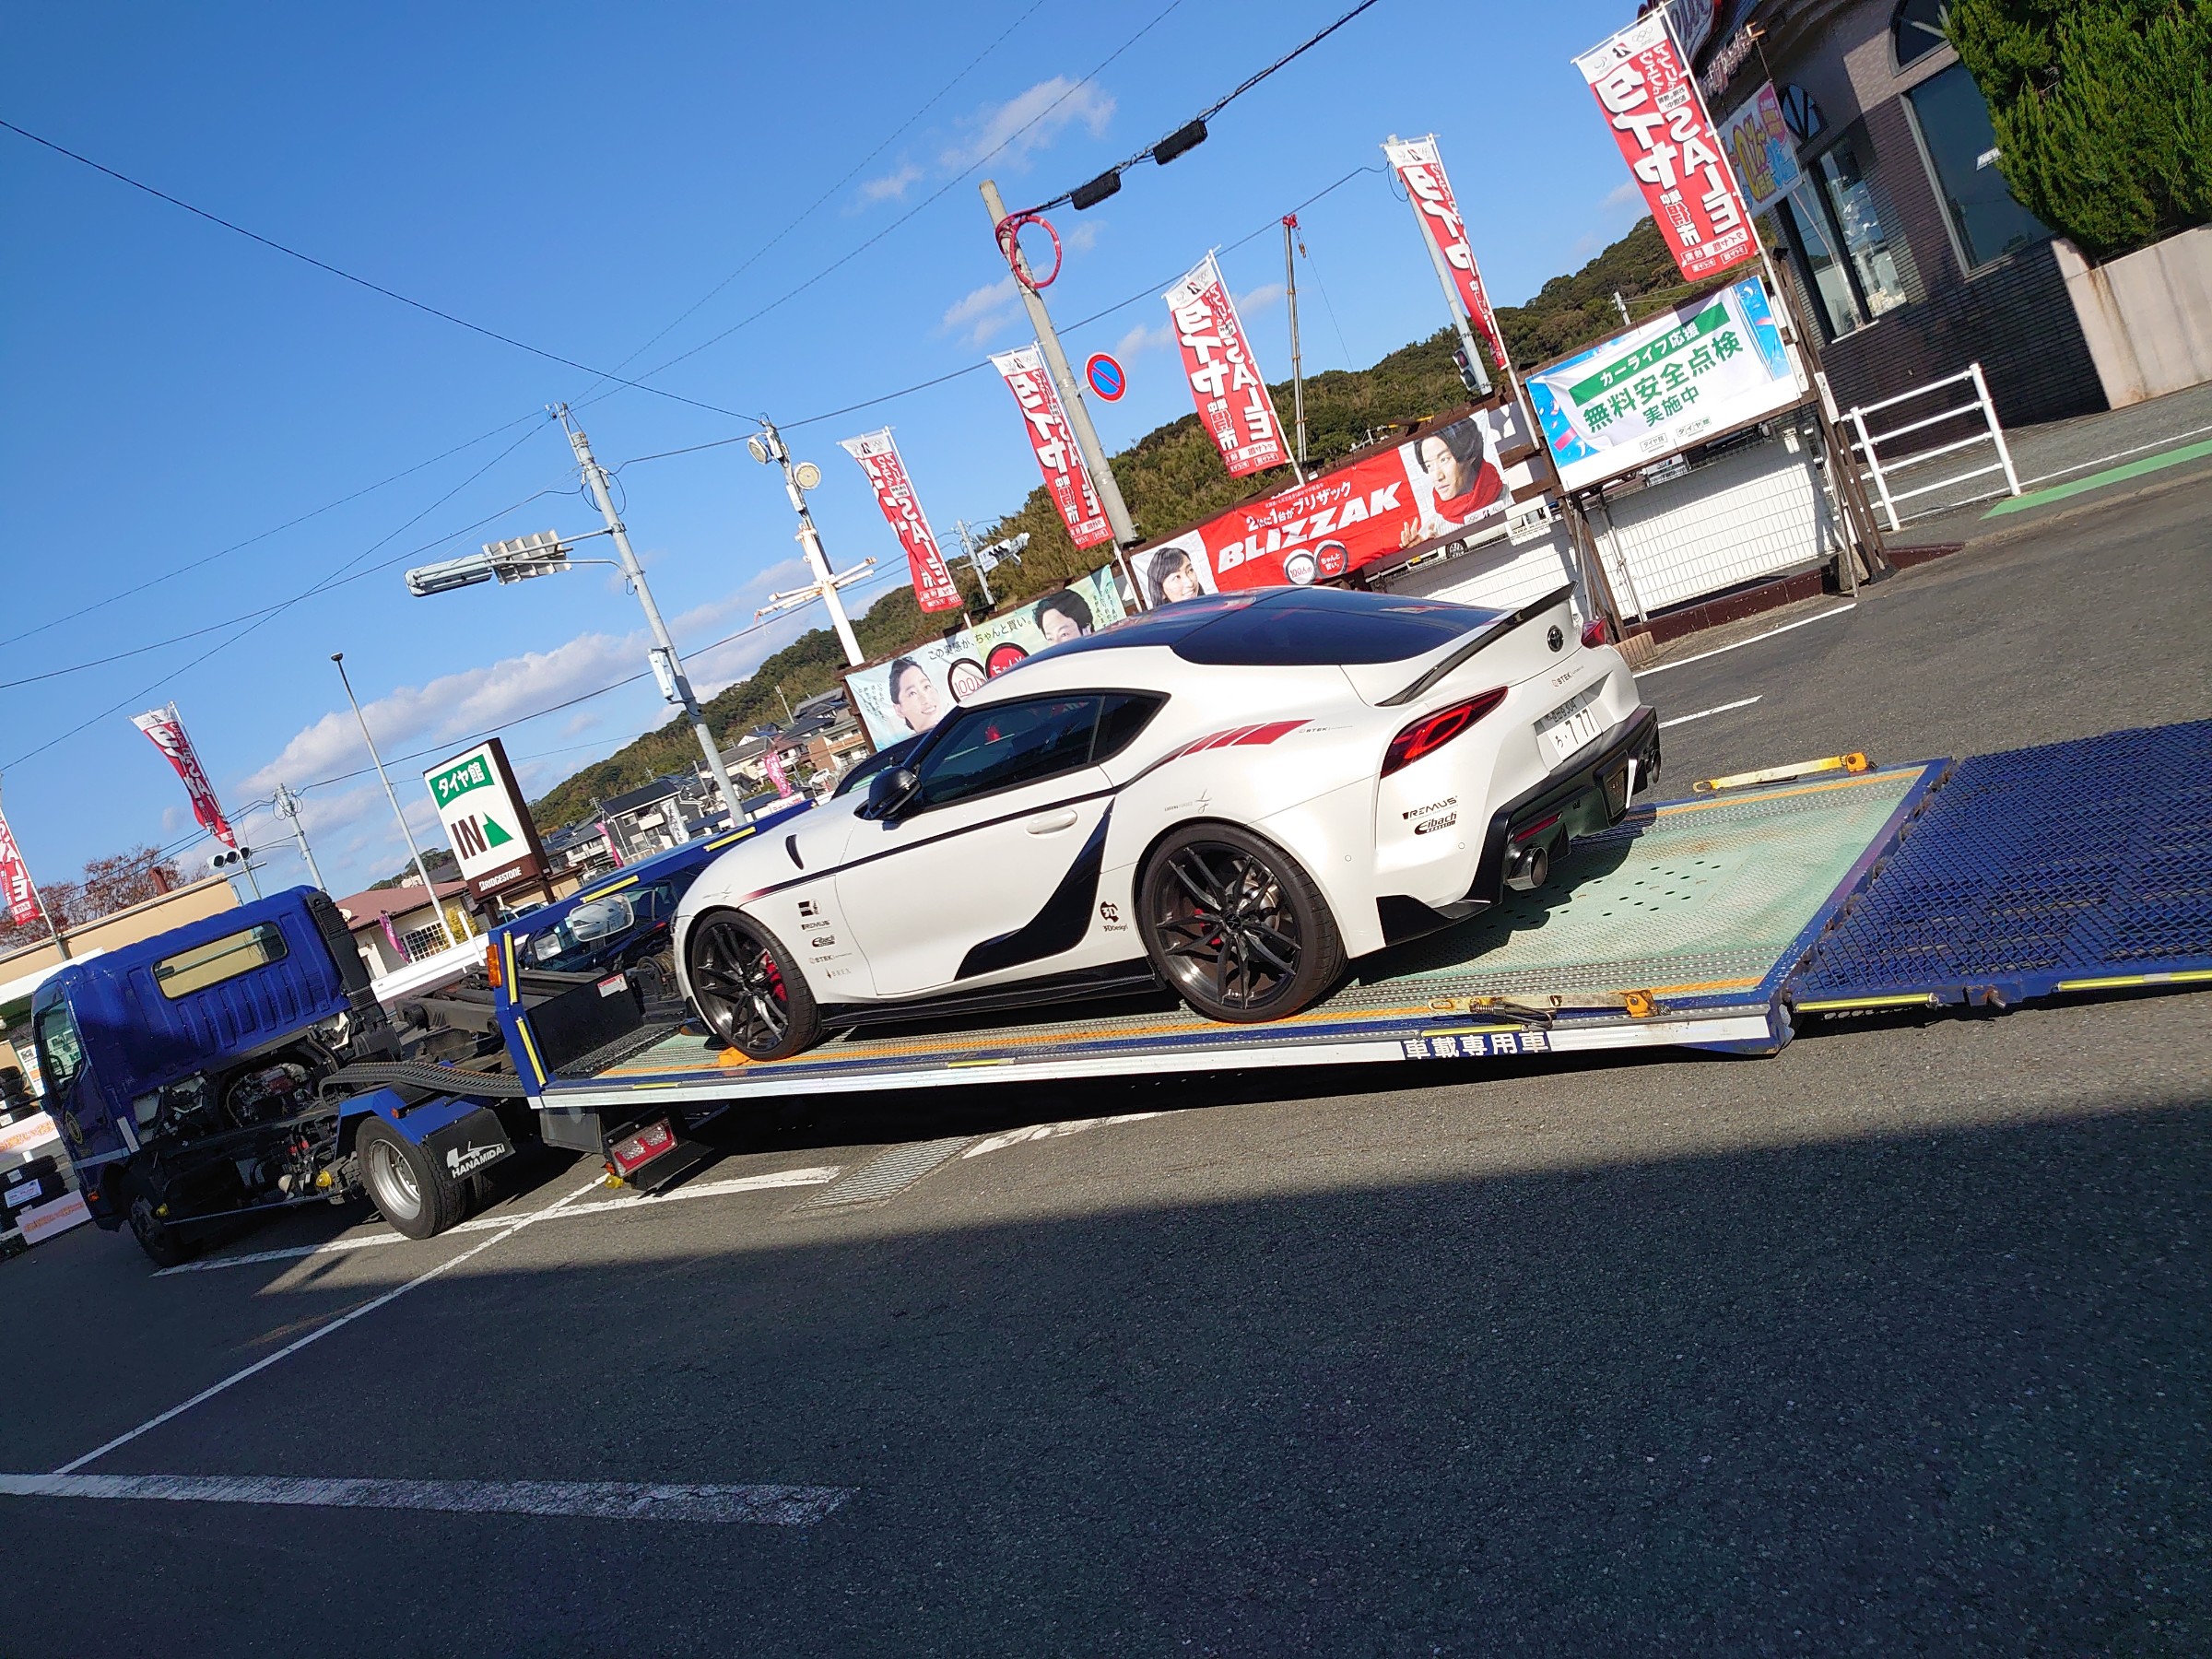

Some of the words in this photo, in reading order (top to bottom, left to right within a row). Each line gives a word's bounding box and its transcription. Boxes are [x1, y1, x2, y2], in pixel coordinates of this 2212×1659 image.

[1600, 321, 1700, 387] カーライフ応援
[1583, 330, 1744, 434] 無料安全点検
[1642, 385, 1700, 428] 実施中
[1218, 481, 1405, 573] BLIZZAK
[438, 761, 486, 799] タイヤ館
[1409, 796, 1457, 818] REMUS
[450, 814, 488, 861] IN
[478, 865, 523, 892] BRIDGESTONE
[1403, 1030, 1548, 1060] 車載専用車
[452, 1143, 506, 1179] HANAMIDAI
